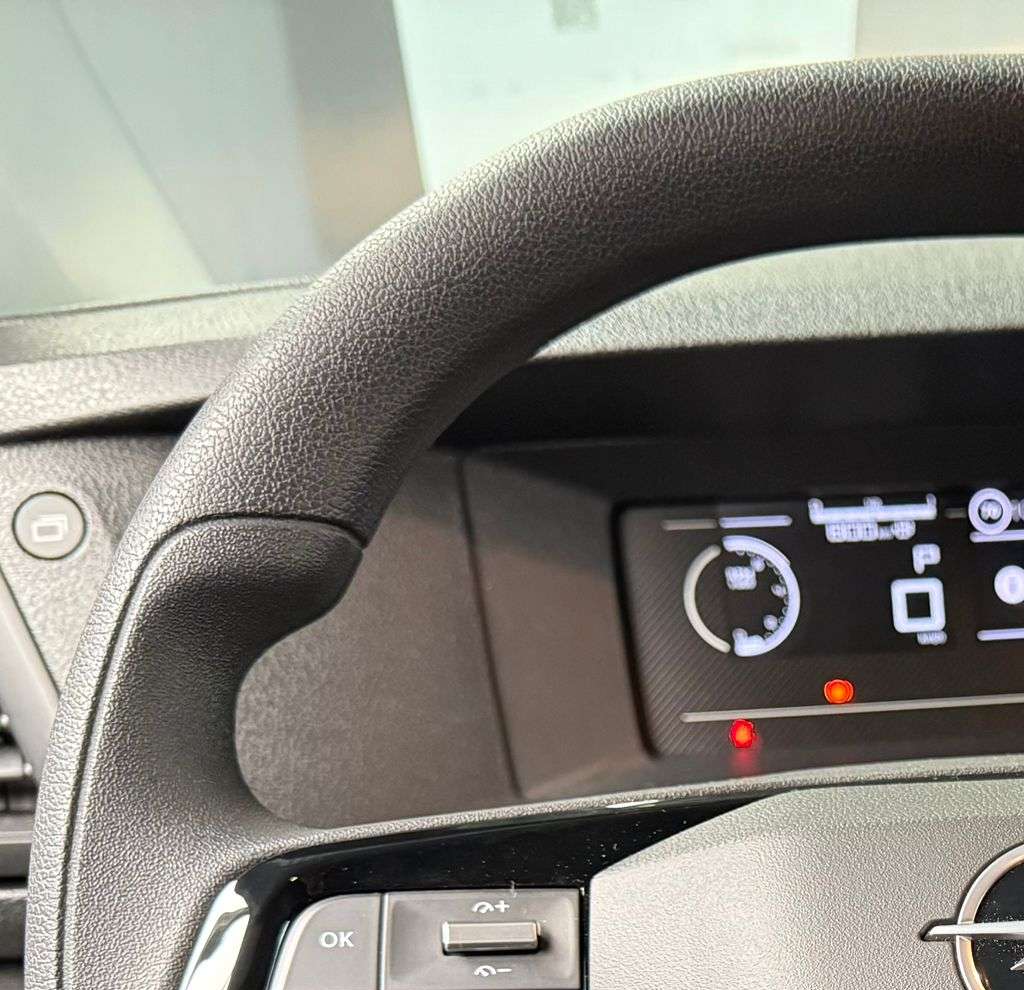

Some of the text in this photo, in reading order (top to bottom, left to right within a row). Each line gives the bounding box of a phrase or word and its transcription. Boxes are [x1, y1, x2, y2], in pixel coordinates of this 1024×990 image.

[912, 543, 941, 574] P
[891, 577, 946, 633] 0
[319, 931, 354, 948] OK
